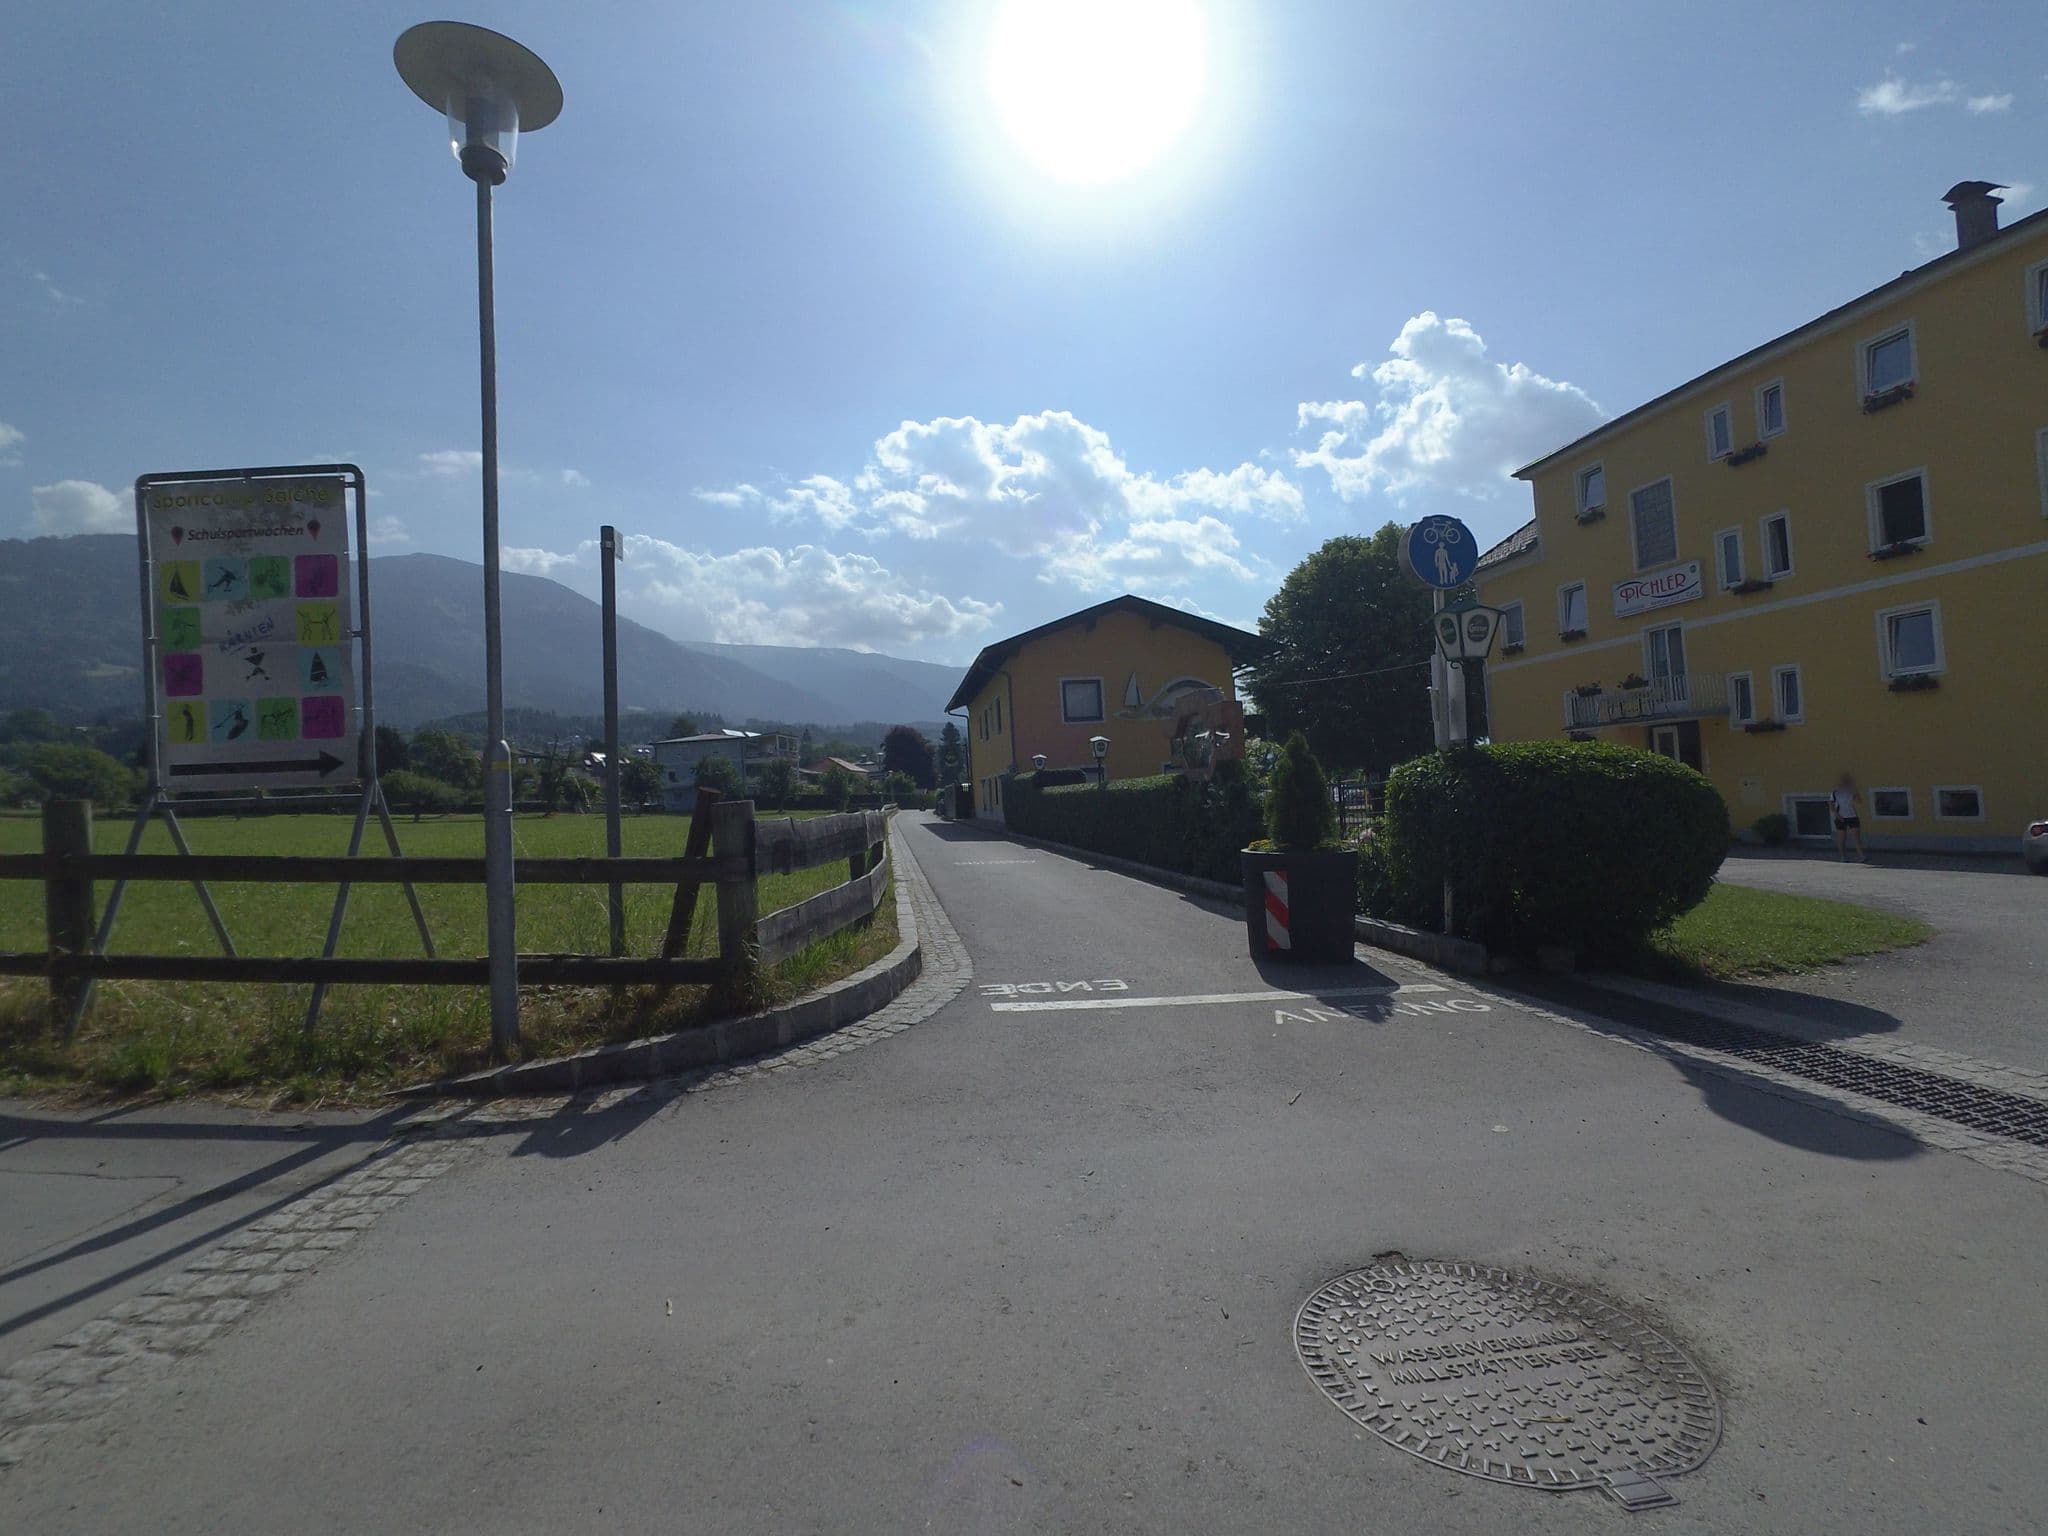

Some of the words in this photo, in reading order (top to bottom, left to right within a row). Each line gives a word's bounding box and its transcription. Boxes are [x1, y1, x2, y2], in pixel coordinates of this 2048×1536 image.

[187, 523, 304, 542] Schulsportwochen
[1619, 572, 1687, 604] PICHLER
[978, 979, 1129, 997] ENDE
[1274, 999, 1492, 1025] ANFANG
[1370, 1328, 1580, 1365] WASSERVERBAND
[1559, 1344, 1608, 1364] SEE
